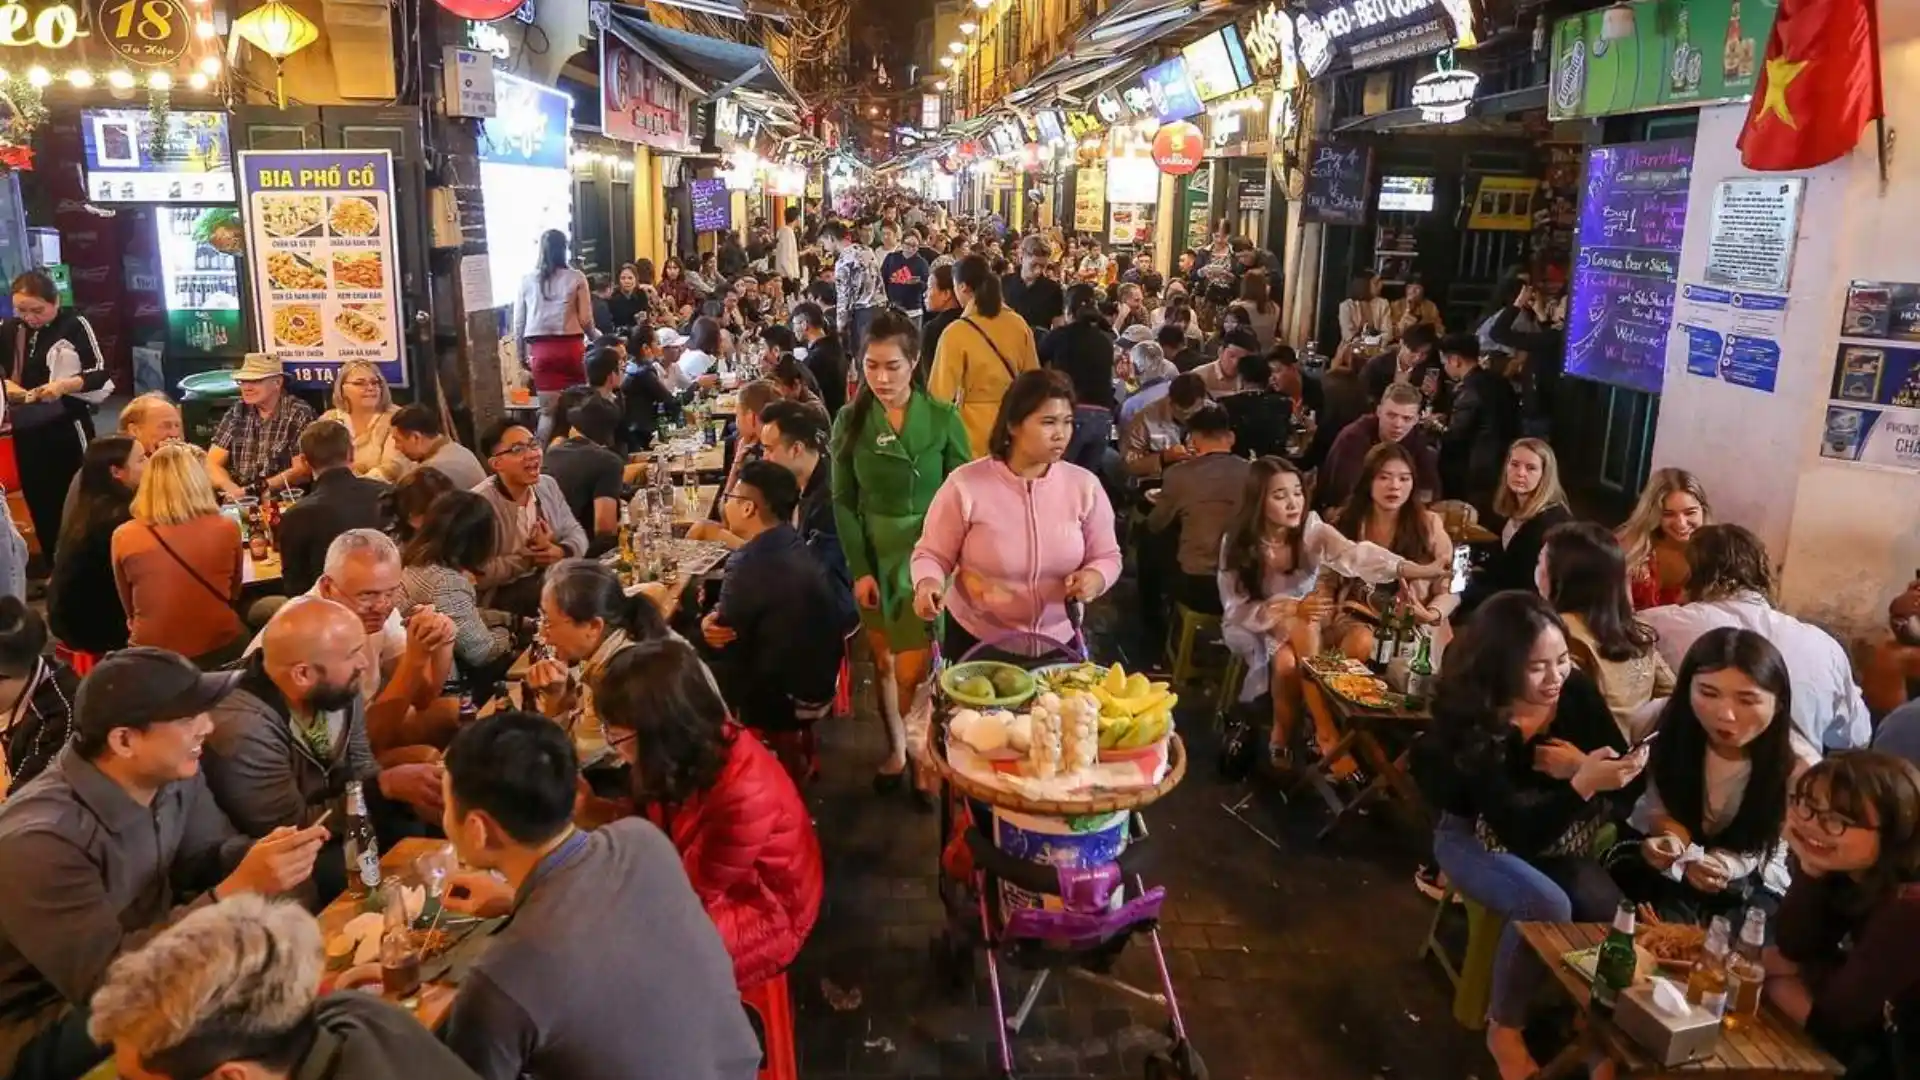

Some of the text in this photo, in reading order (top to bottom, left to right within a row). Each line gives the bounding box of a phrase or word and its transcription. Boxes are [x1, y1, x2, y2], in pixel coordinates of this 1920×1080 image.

[111, 0, 173, 40] 18
[259, 161, 376, 187] BIA PHỐ CỔ
[1602, 205, 1629, 221] Buy
[1577, 247, 1591, 269] 5
[294, 368, 334, 384] 18 TẠ
